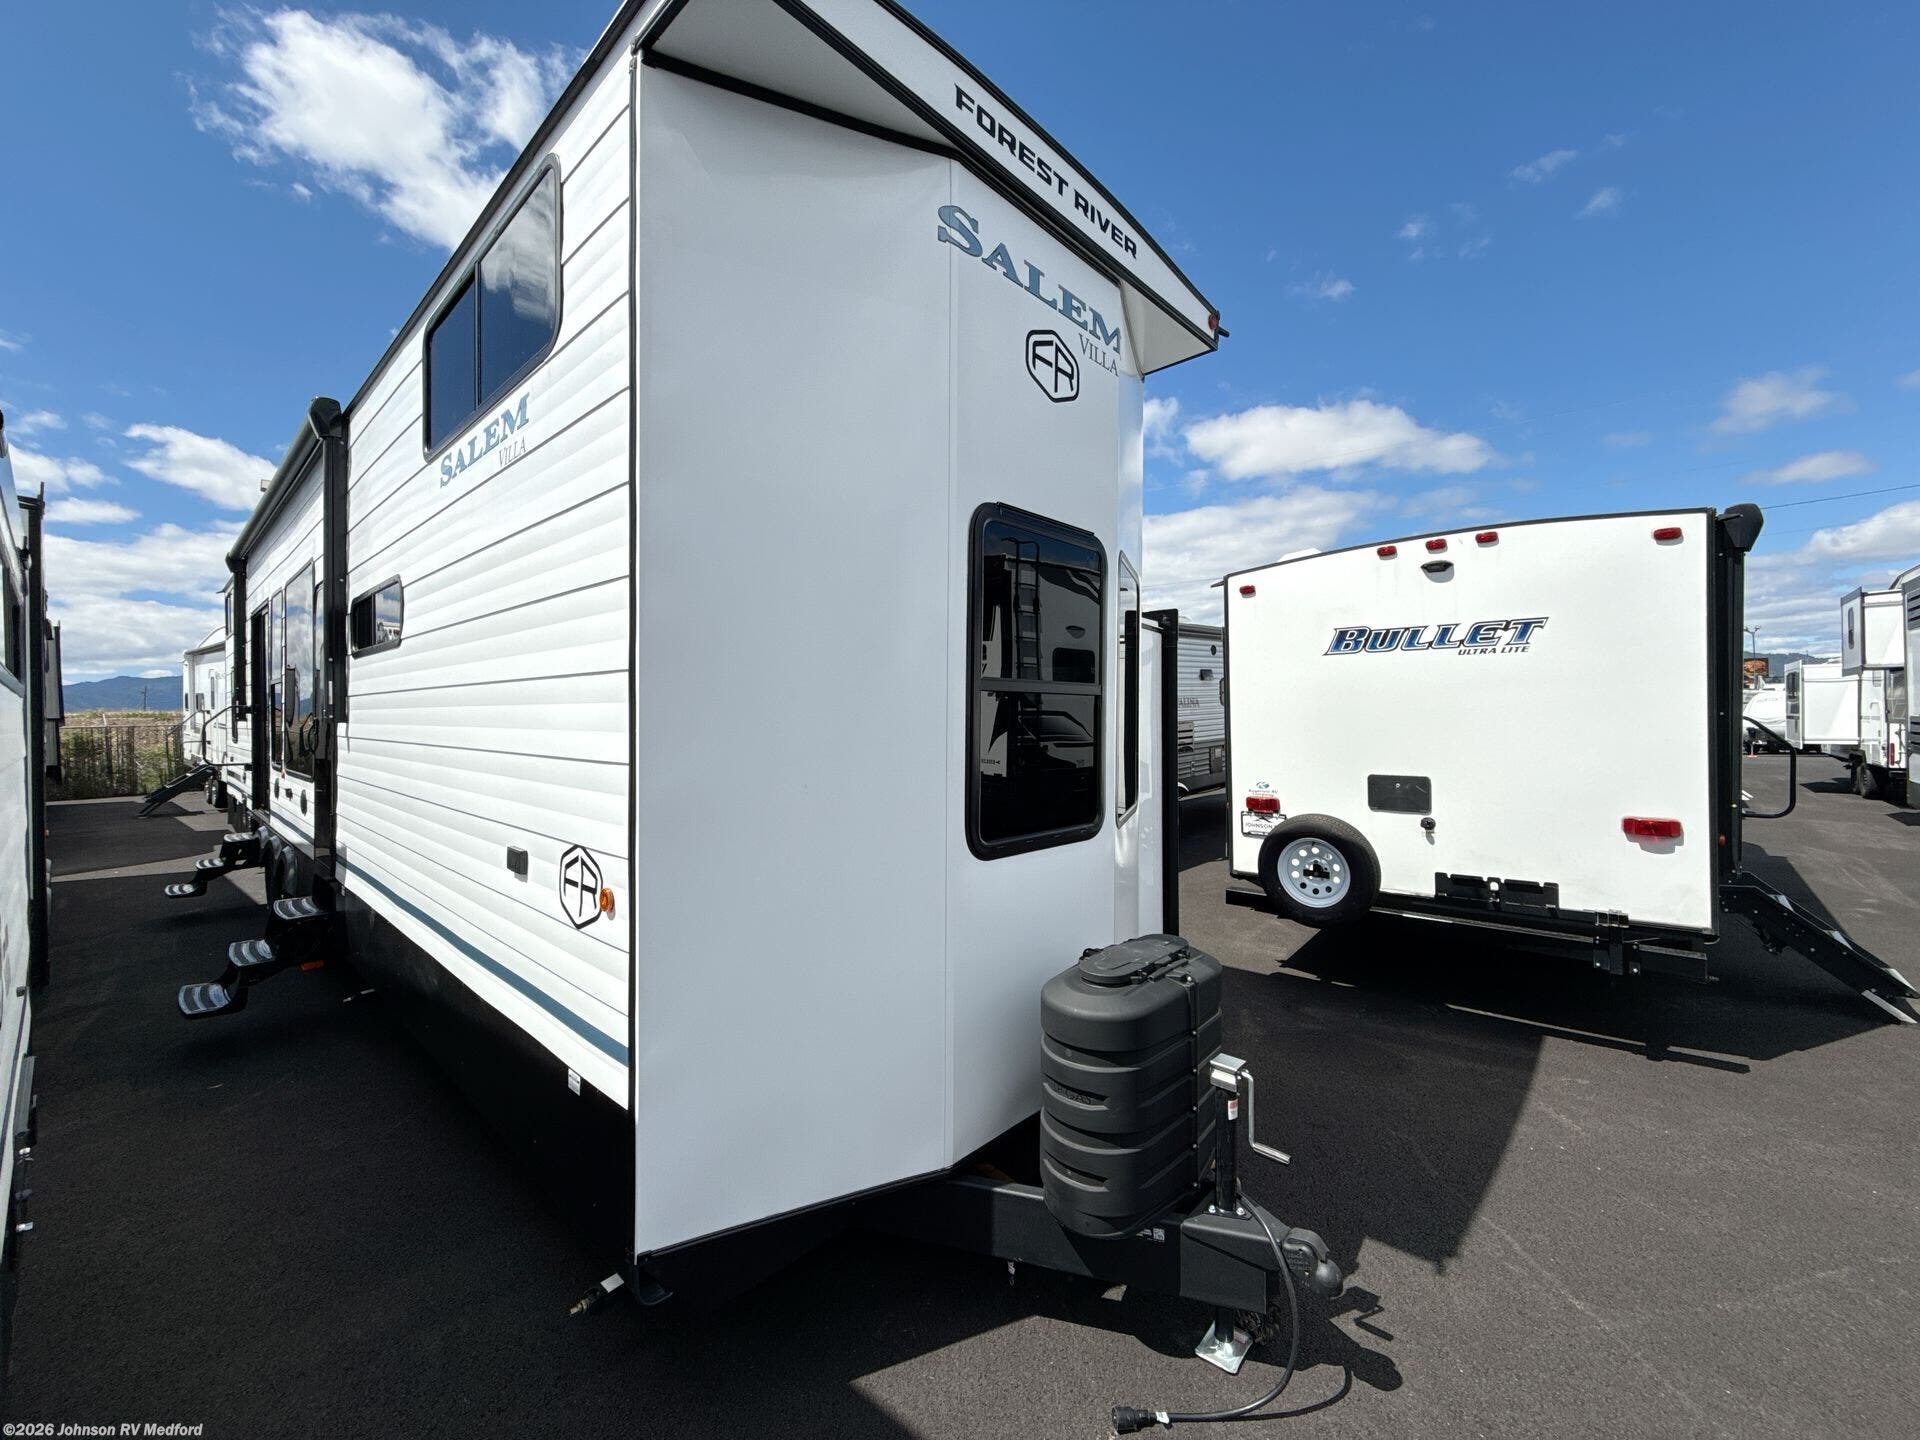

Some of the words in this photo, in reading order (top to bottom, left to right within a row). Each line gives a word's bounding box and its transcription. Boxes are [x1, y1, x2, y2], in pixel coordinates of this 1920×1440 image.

[954, 83, 1069, 197] FOREST
[1074, 188, 1137, 260] RIVER
[937, 204, 1122, 359] SALEM
[1078, 332, 1119, 377] VILLA
[440, 391, 530, 489] SALEM
[499, 435, 527, 468] VILLA
[1322, 616, 1549, 656] BULLET
[1457, 647, 1497, 656] ULTRA
[1500, 645, 1530, 654] LITE
[1245, 822, 1273, 830] JOHNSON
